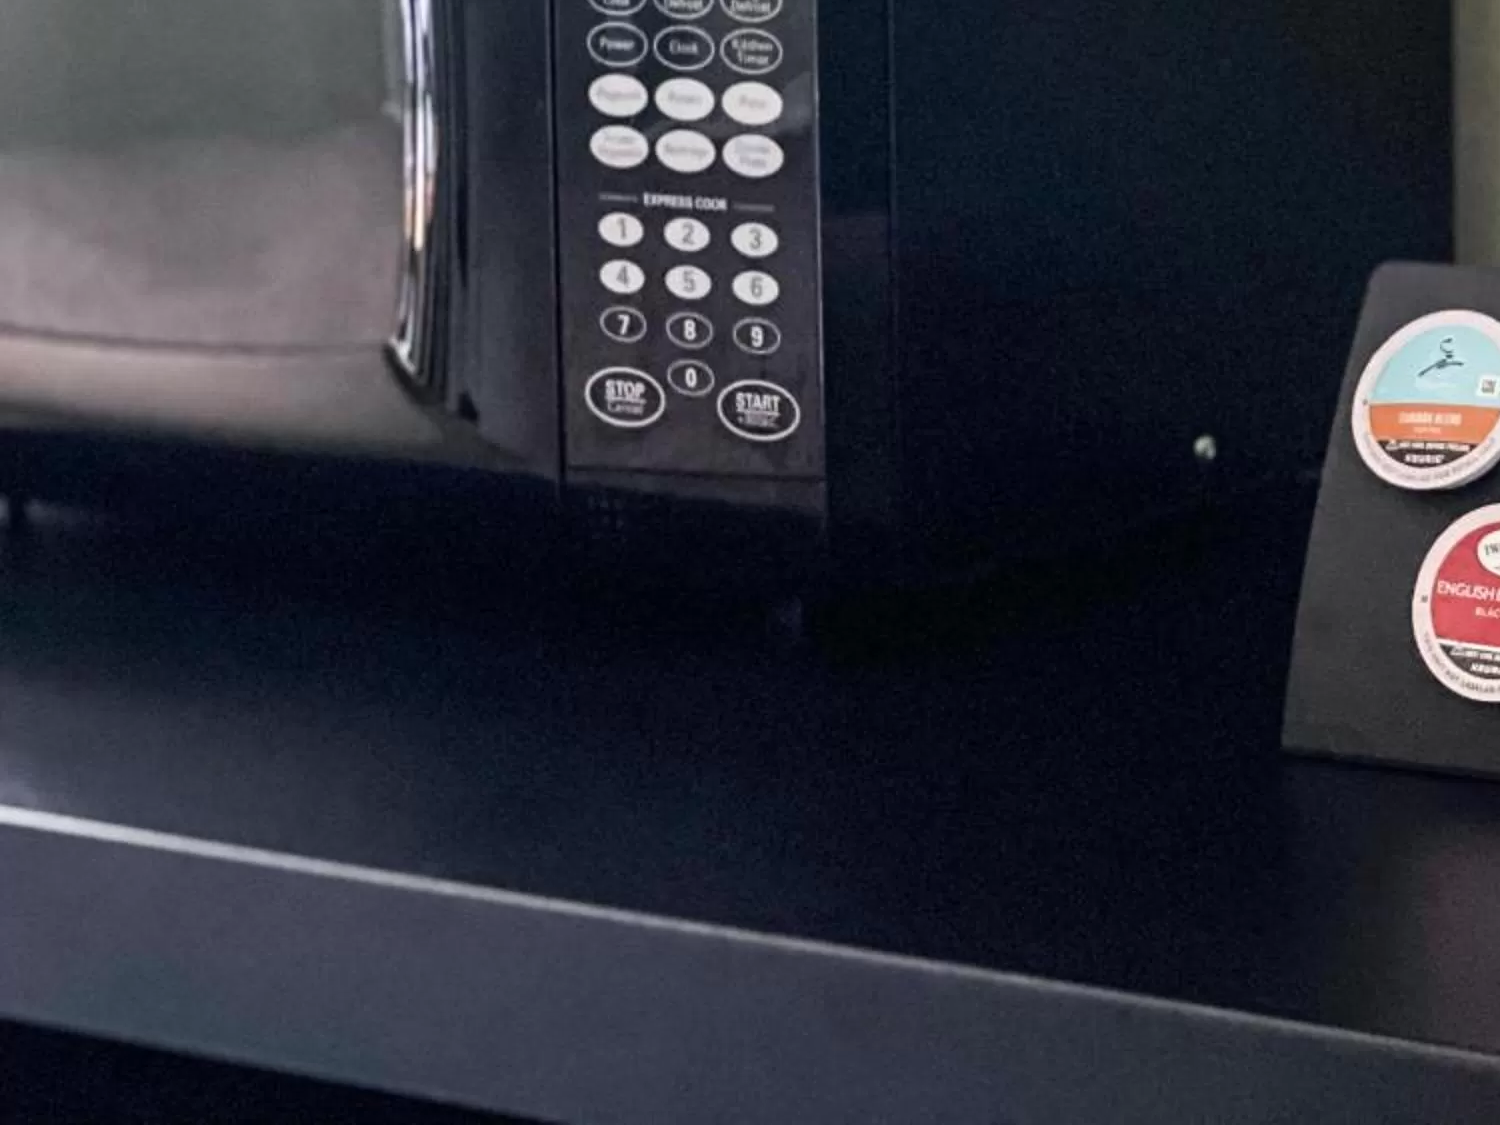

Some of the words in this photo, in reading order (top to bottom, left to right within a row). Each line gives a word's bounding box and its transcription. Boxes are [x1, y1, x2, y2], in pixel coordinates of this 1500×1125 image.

[643, 192, 693, 210] EXPRESS
[695, 194, 728, 211] COOK
[617, 218, 627, 239] 1
[681, 222, 695, 245] 2
[748, 228, 762, 250] 3
[616, 265, 629, 286] 4
[682, 271, 696, 293] 5
[750, 277, 763, 298] 6
[617, 314, 631, 336] 7
[683, 319, 696, 340] 8
[751, 326, 763, 347] 9
[685, 367, 697, 388] 0
[605, 379, 646, 399] STOP
[736, 392, 780, 412] START
[1437, 580, 1496, 601] ENGLISH
